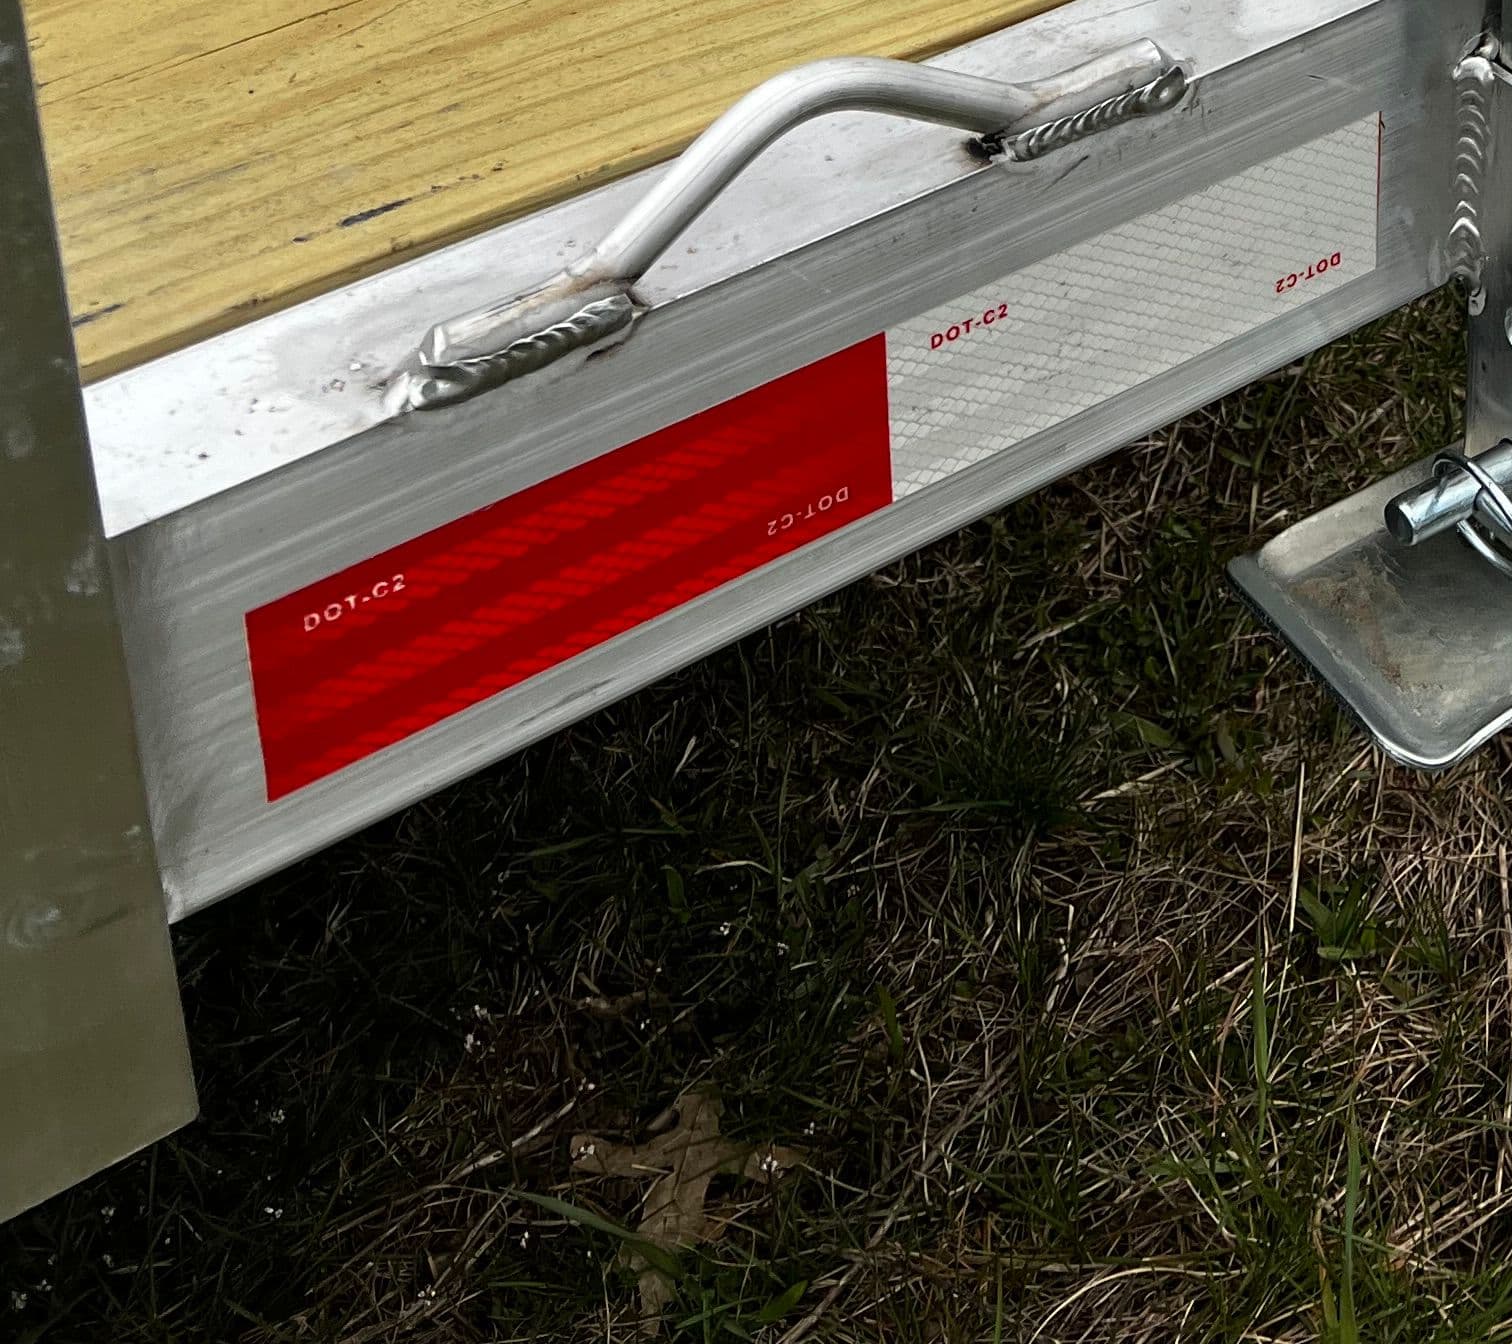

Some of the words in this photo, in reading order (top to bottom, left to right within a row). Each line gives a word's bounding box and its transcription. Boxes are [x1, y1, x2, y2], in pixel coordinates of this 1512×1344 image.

[1275, 251, 1342, 294] DOT-C2
[929, 303, 1009, 350] DOT-C2
[766, 485, 850, 537] DOT-C2
[303, 573, 407, 633] DOT-C2
